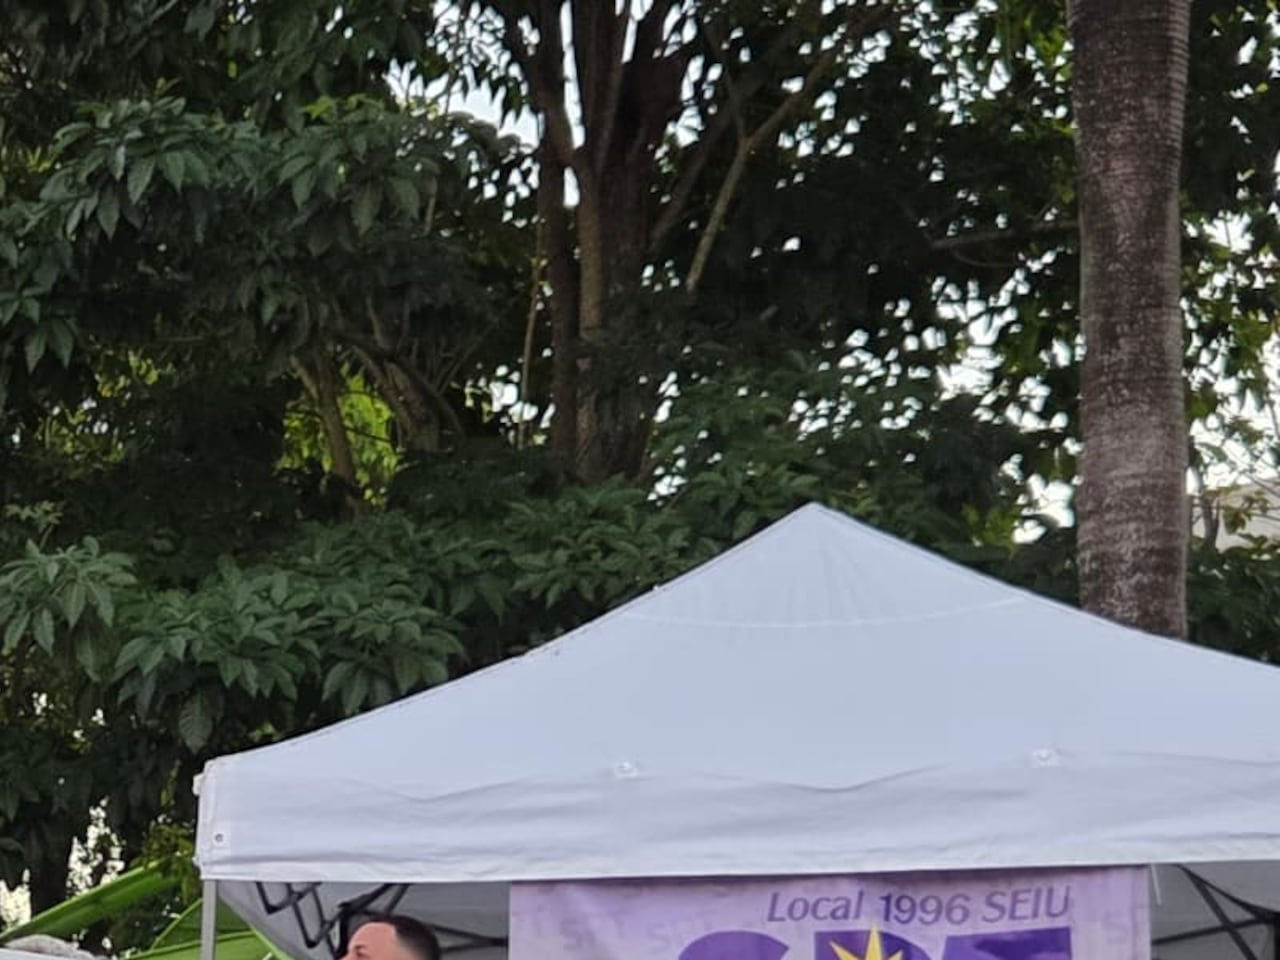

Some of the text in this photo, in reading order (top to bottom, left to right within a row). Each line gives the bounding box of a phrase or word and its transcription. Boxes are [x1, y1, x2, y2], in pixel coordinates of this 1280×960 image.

[766, 885, 1072, 926] Local 1996 SEIU
